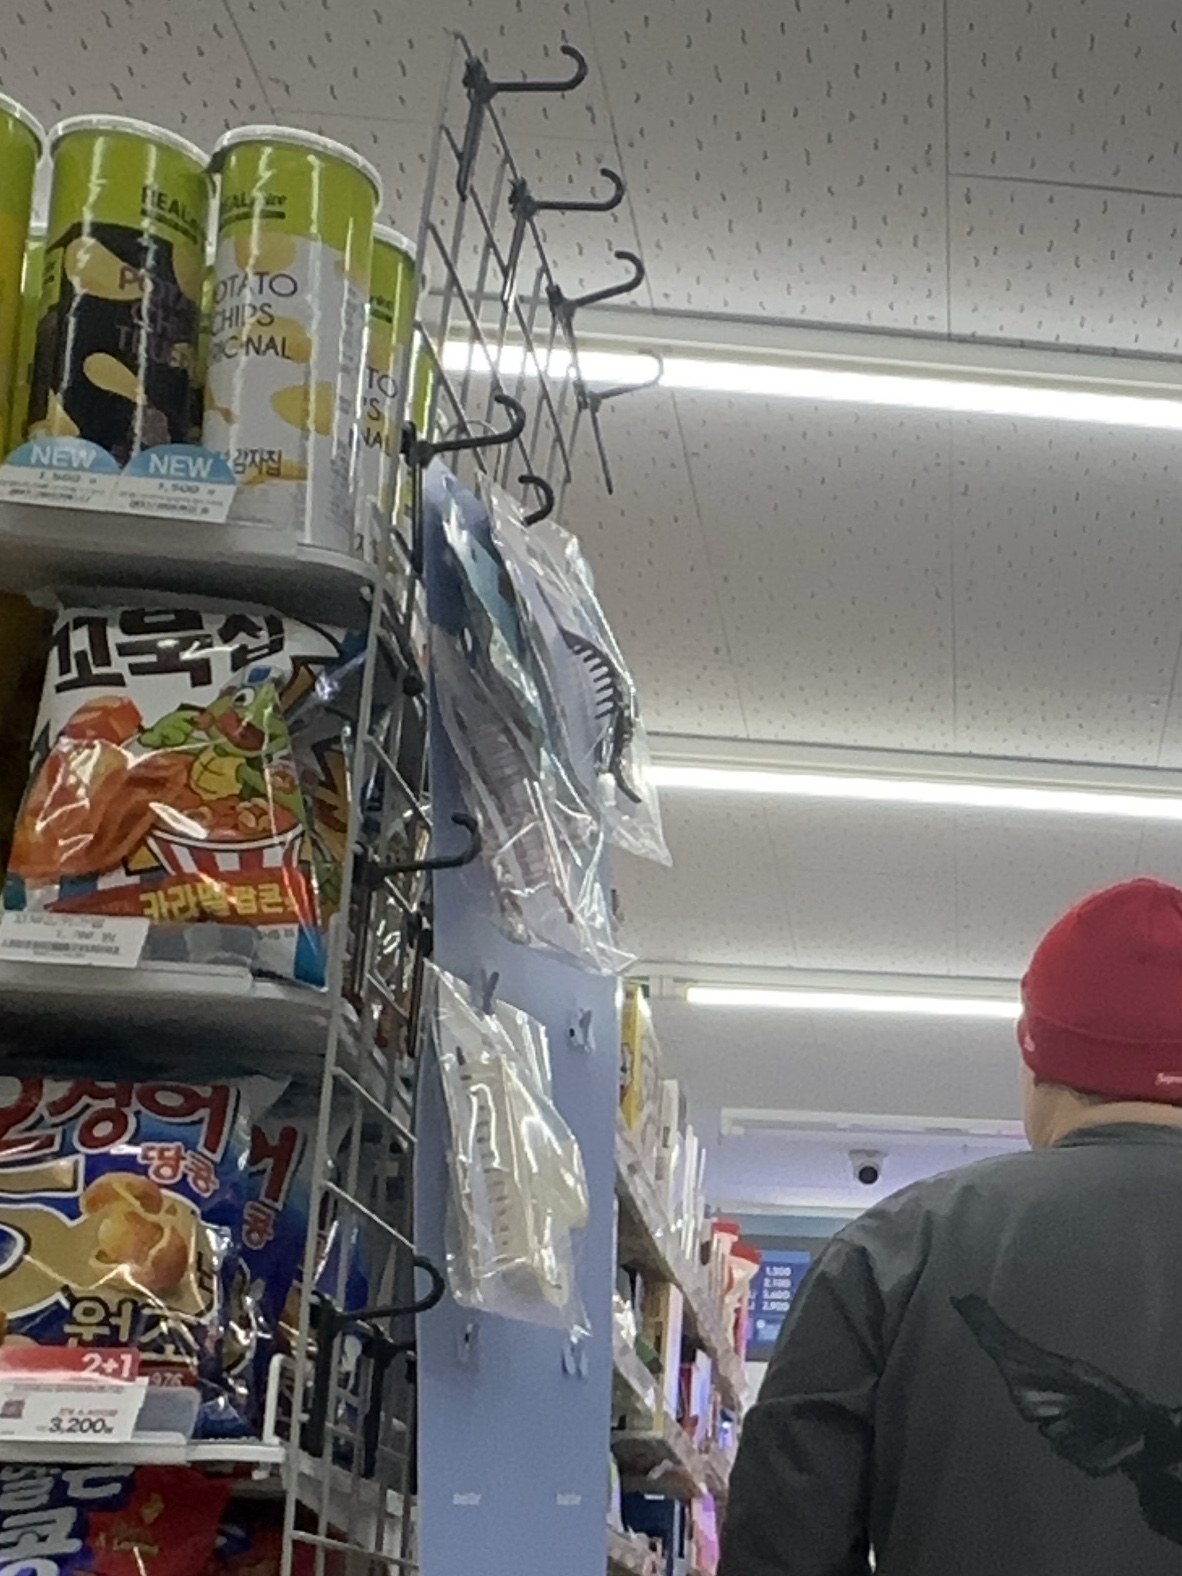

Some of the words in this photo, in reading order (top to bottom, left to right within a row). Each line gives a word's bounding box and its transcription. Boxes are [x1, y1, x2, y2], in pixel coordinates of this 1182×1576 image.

[213, 271, 298, 304] OTATO
[30, 445, 97, 470] NEW
[149, 453, 212, 479] NEW
[82, 1353, 133, 1379] 2+1
[152, 1373, 184, 1388] 976
